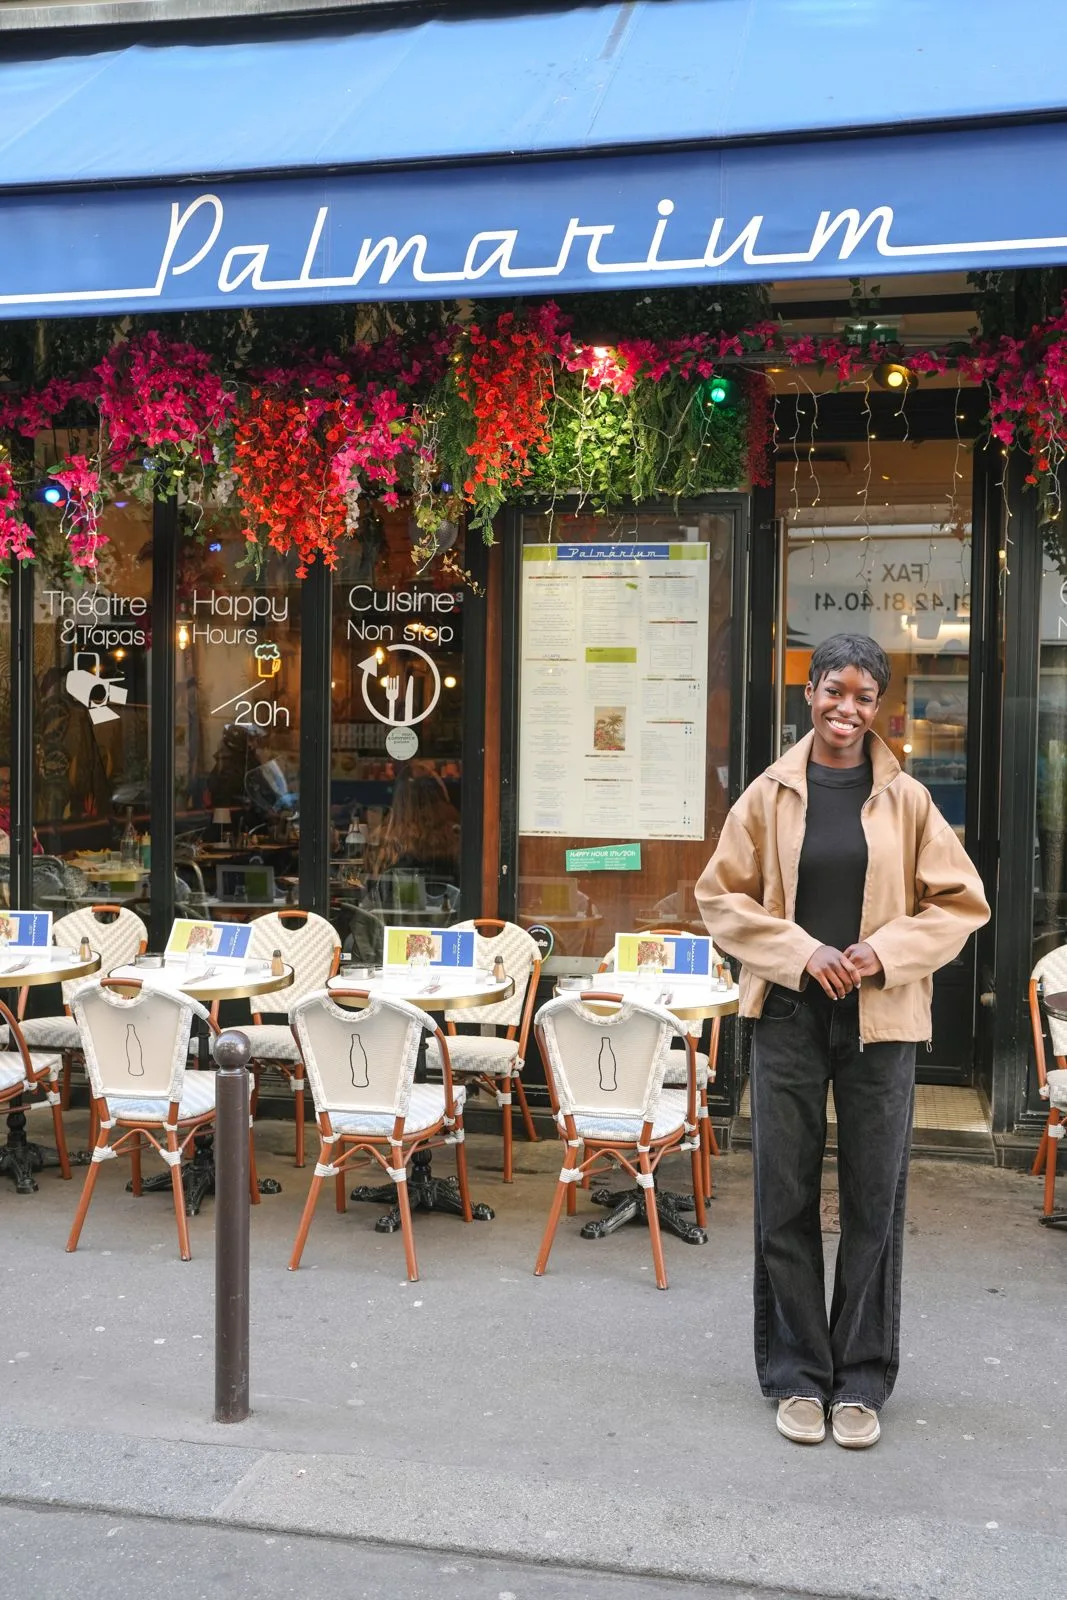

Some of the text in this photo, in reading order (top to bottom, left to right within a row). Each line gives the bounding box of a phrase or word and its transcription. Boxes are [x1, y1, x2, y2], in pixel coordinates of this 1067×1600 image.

[155, 193, 897, 297] Palmarium
[568, 547, 657, 560] Palmarium
[193, 589, 289, 622] Happy
[349, 584, 455, 613] Cuisine
[193, 624, 258, 645] Hours
[347, 619, 454, 647] Non stop
